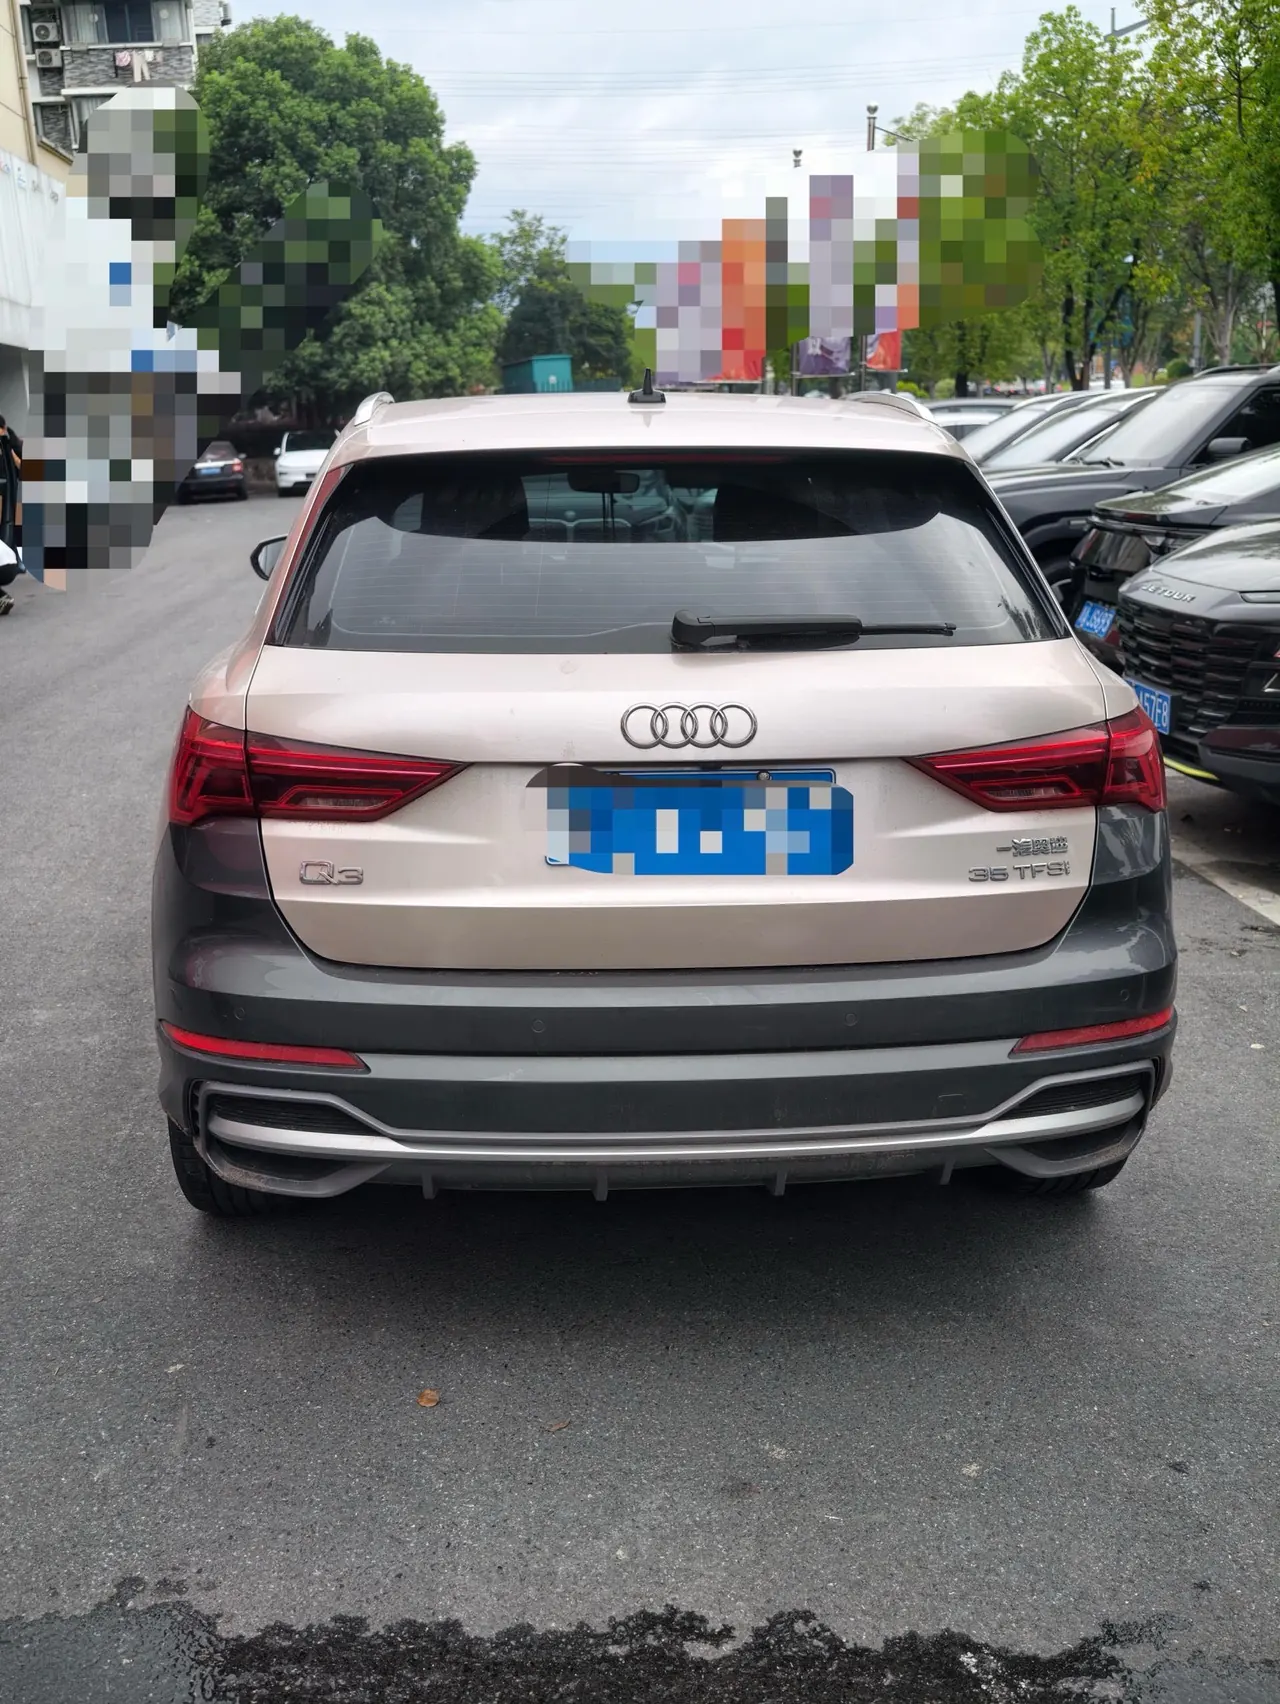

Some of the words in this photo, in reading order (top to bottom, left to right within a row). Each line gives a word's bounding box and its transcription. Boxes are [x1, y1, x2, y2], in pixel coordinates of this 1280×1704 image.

[1141, 584, 1196, 602] JETOUR
[996, 836, 1069, 857] 一汽奥迪
[299, 860, 364, 886] Q3
[968, 865, 1009, 882] 35
[1013, 860, 1071, 880] TFSI
